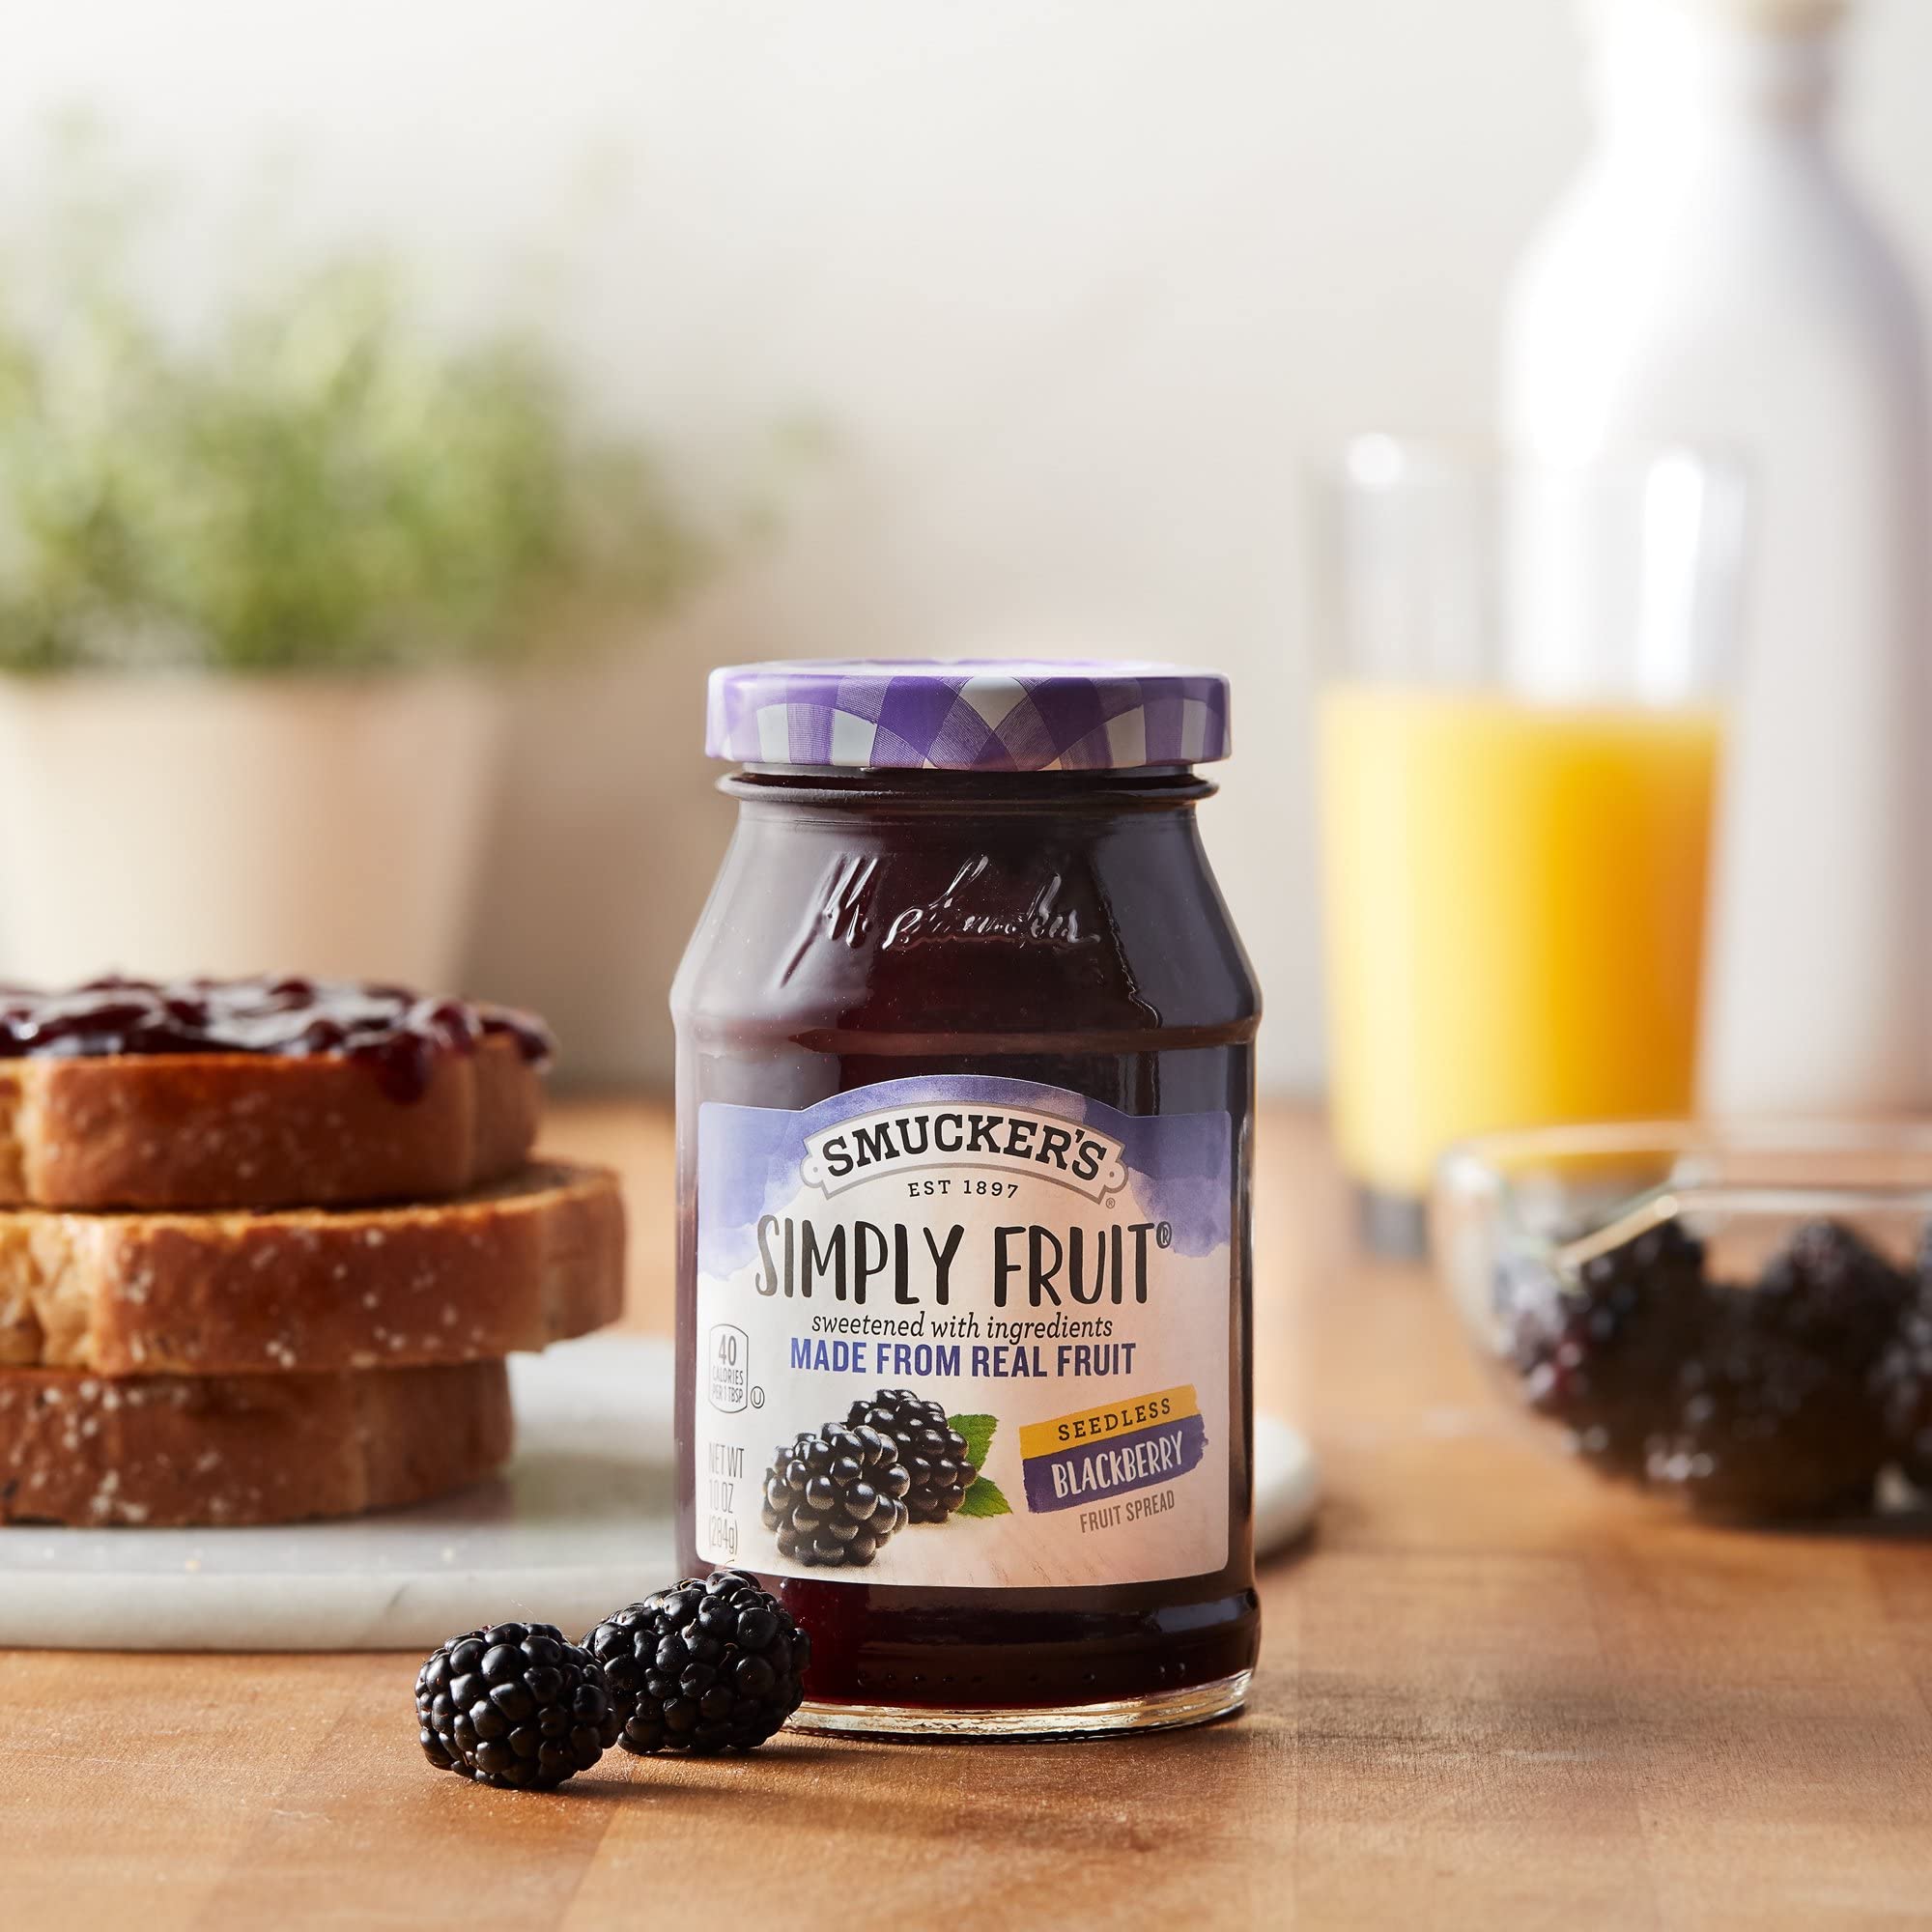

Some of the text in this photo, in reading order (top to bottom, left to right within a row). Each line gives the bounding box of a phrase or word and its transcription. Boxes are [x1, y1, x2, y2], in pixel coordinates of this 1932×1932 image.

[822, 1114, 1108, 1180] SMUCKER'S
[908, 1179, 1019, 1199] EST 1897
[755, 1214, 965, 1305] SIMPLY
[811, 1310, 1113, 1345] sweetened with ingredients
[718, 1333, 737, 1366] 40
[790, 1337, 1136, 1378] MADE FROM REAL FRUIT
[713, 1366, 744, 1385] CALORIES
[1058, 1398, 1171, 1441] SEEDLESS
[709, 1441, 745, 1479] NET WT
[1051, 1430, 1183, 1499] BLACKBERRY
[709, 1479, 734, 1514] 10 OZ
[1079, 1490, 1176, 1533] FRUIT SPREAD
[709, 1515, 739, 1555] (284g)
